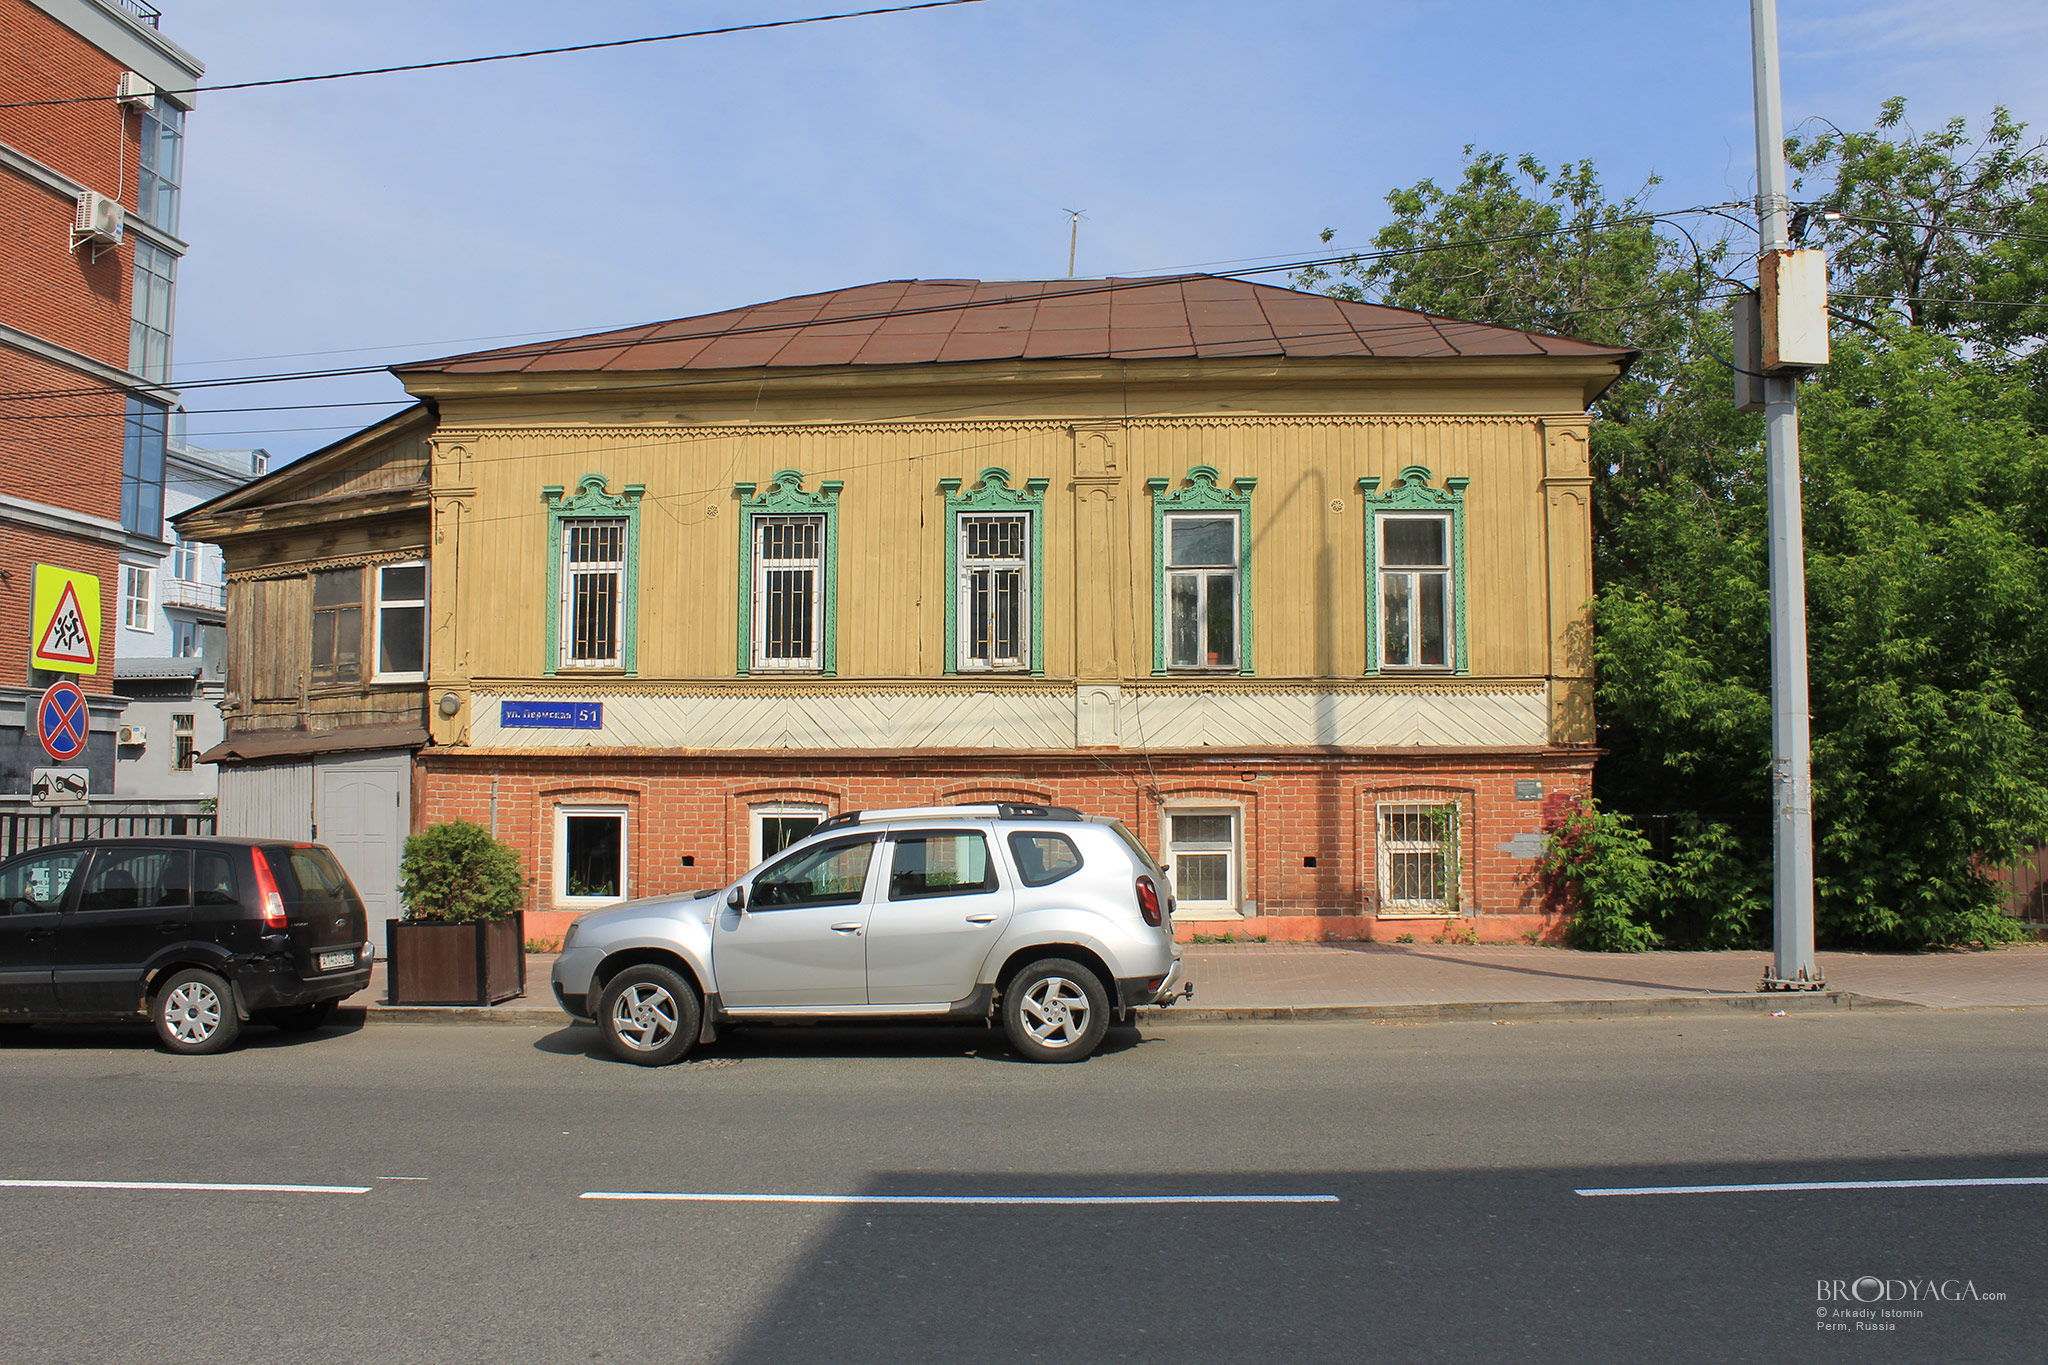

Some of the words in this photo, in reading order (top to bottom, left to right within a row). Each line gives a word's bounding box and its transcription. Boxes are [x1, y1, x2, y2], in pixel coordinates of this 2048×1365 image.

[506, 710, 521, 720] ул.
[523, 709, 572, 721] Пермская
[579, 709, 598, 722] 51
